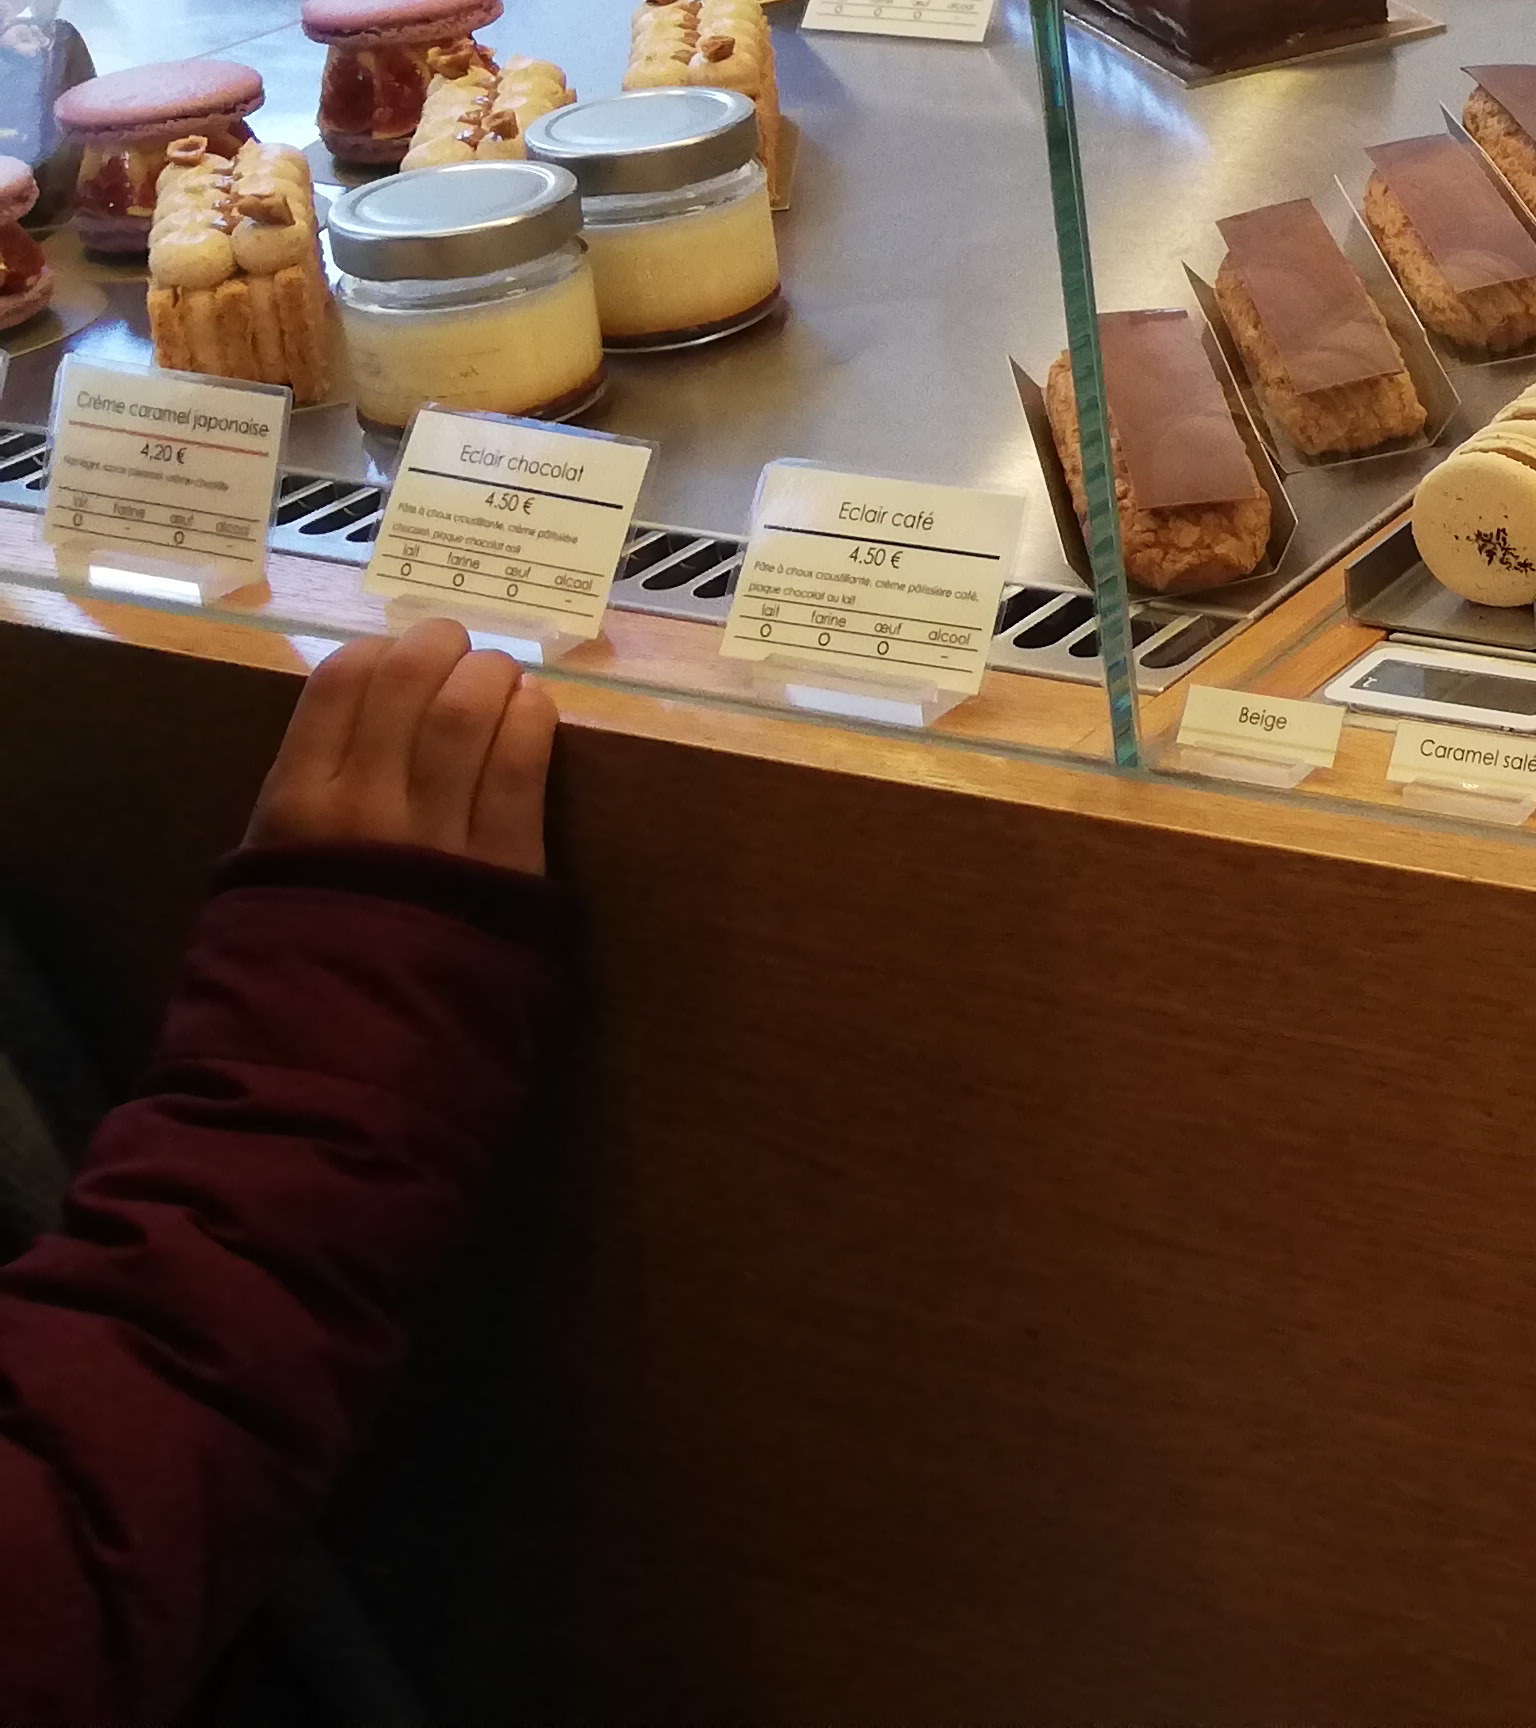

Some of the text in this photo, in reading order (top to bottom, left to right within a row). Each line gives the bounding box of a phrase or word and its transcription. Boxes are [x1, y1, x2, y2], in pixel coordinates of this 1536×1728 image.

[76, 390, 271, 438] Crème caramel japonaise
[176, 446, 188, 465] €
[460, 445, 585, 483] Eclair chocolat
[485, 492, 535, 515] 4.50 €
[838, 501, 934, 531] Eclair café
[848, 545, 903, 570] 4.50 €
[811, 610, 847, 628] farine
[928, 628, 971, 646] alcool
[1238, 706, 1288, 730] Beige
[1420, 738, 1499, 768] Caramel
